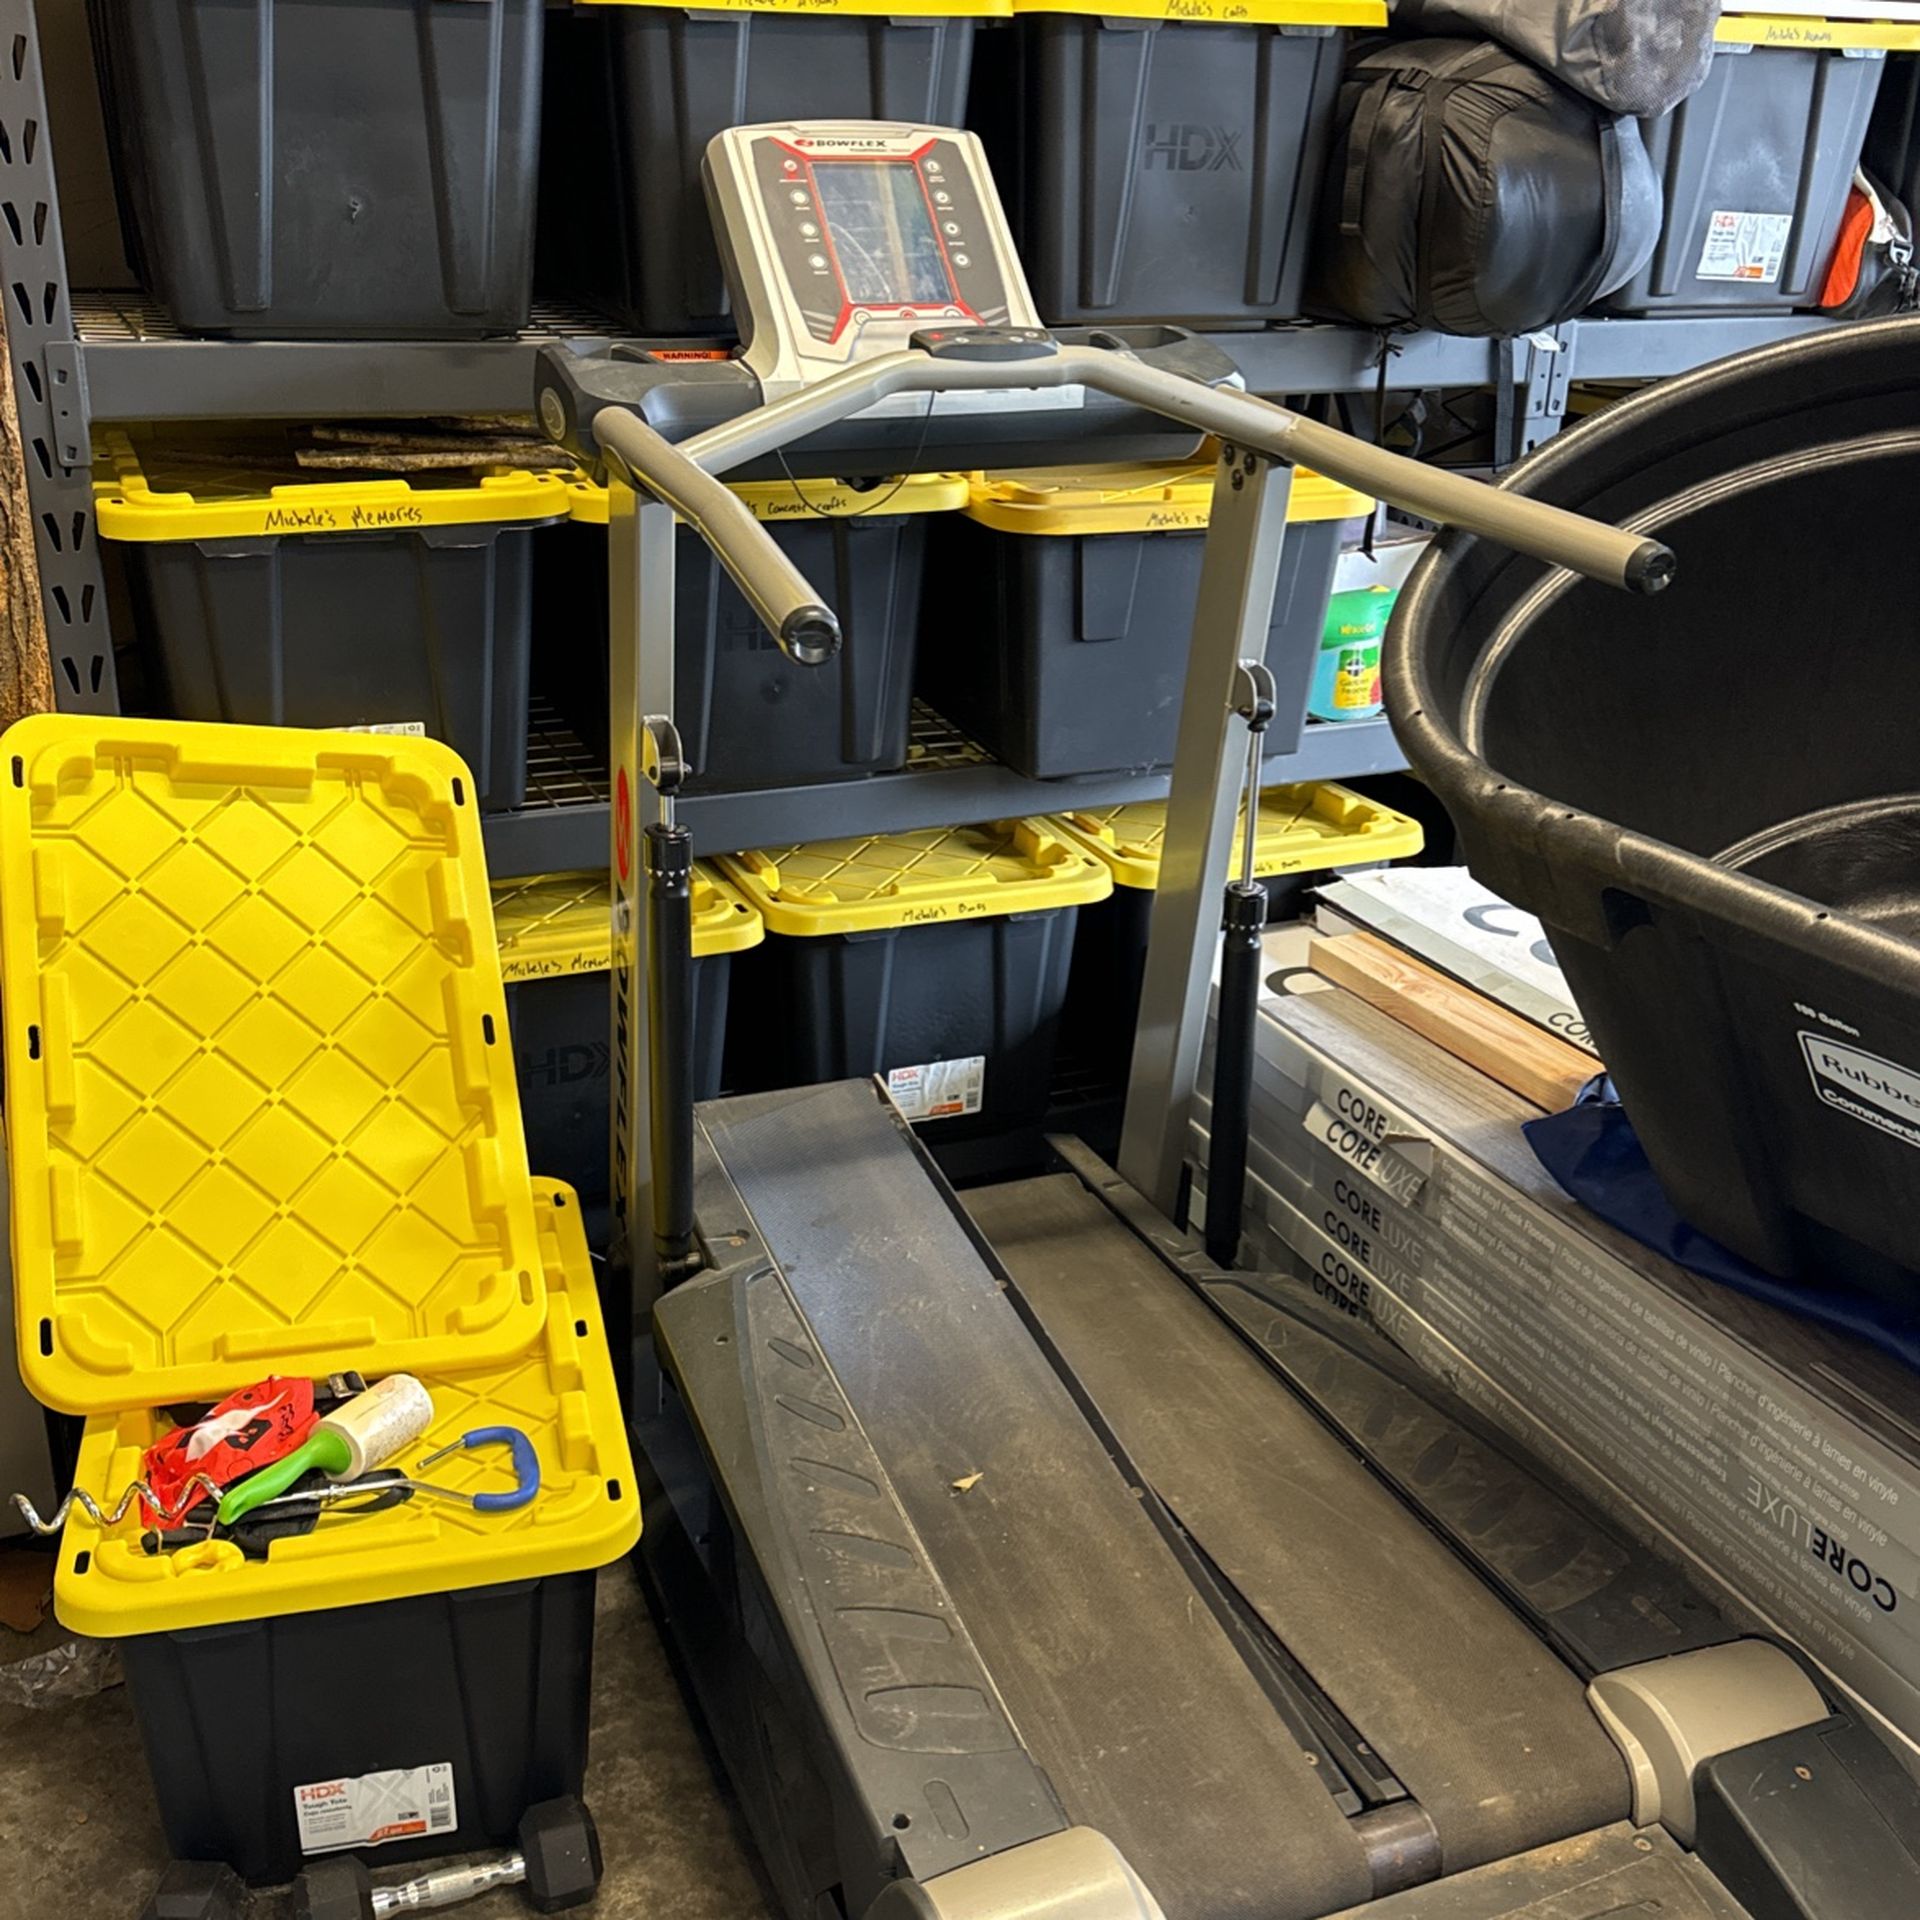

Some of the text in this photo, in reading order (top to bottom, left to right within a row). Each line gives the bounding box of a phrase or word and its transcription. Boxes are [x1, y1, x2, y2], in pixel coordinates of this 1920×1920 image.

[816, 140, 887, 148] BOWFLEX
[1144, 124, 1244, 172] HDX
[265, 507, 337, 530] Michele's
[1337, 1088, 1395, 1140] CORE
[1500, 1201, 1523, 1226] Plank
[1820, 1438, 1852, 1472] lames
[1851, 1463, 1868, 1484] en
[1866, 1473, 1898, 1507] vinyle
[1841, 1505, 1857, 1526] en
[300, 1783, 345, 1801] HDX
